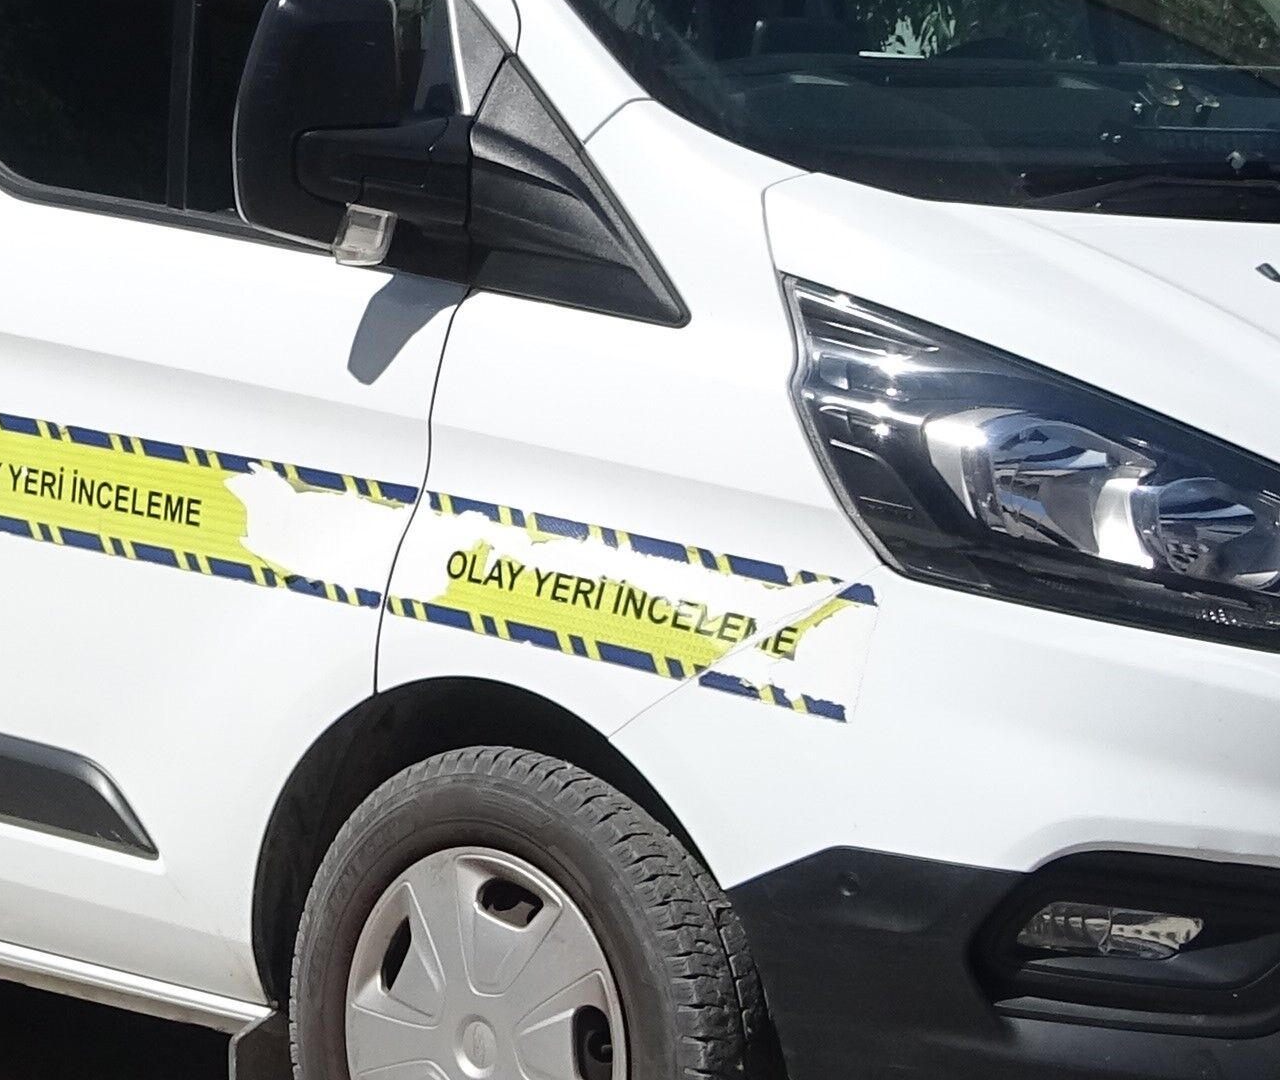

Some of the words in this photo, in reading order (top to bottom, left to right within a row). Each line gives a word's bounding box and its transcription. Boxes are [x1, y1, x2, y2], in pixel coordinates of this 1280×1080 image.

[8, 463, 66, 501] YERİ
[70, 469, 203, 527] İNCELEME
[446, 549, 527, 592] OLAY
[532, 566, 609, 612] YERİ
